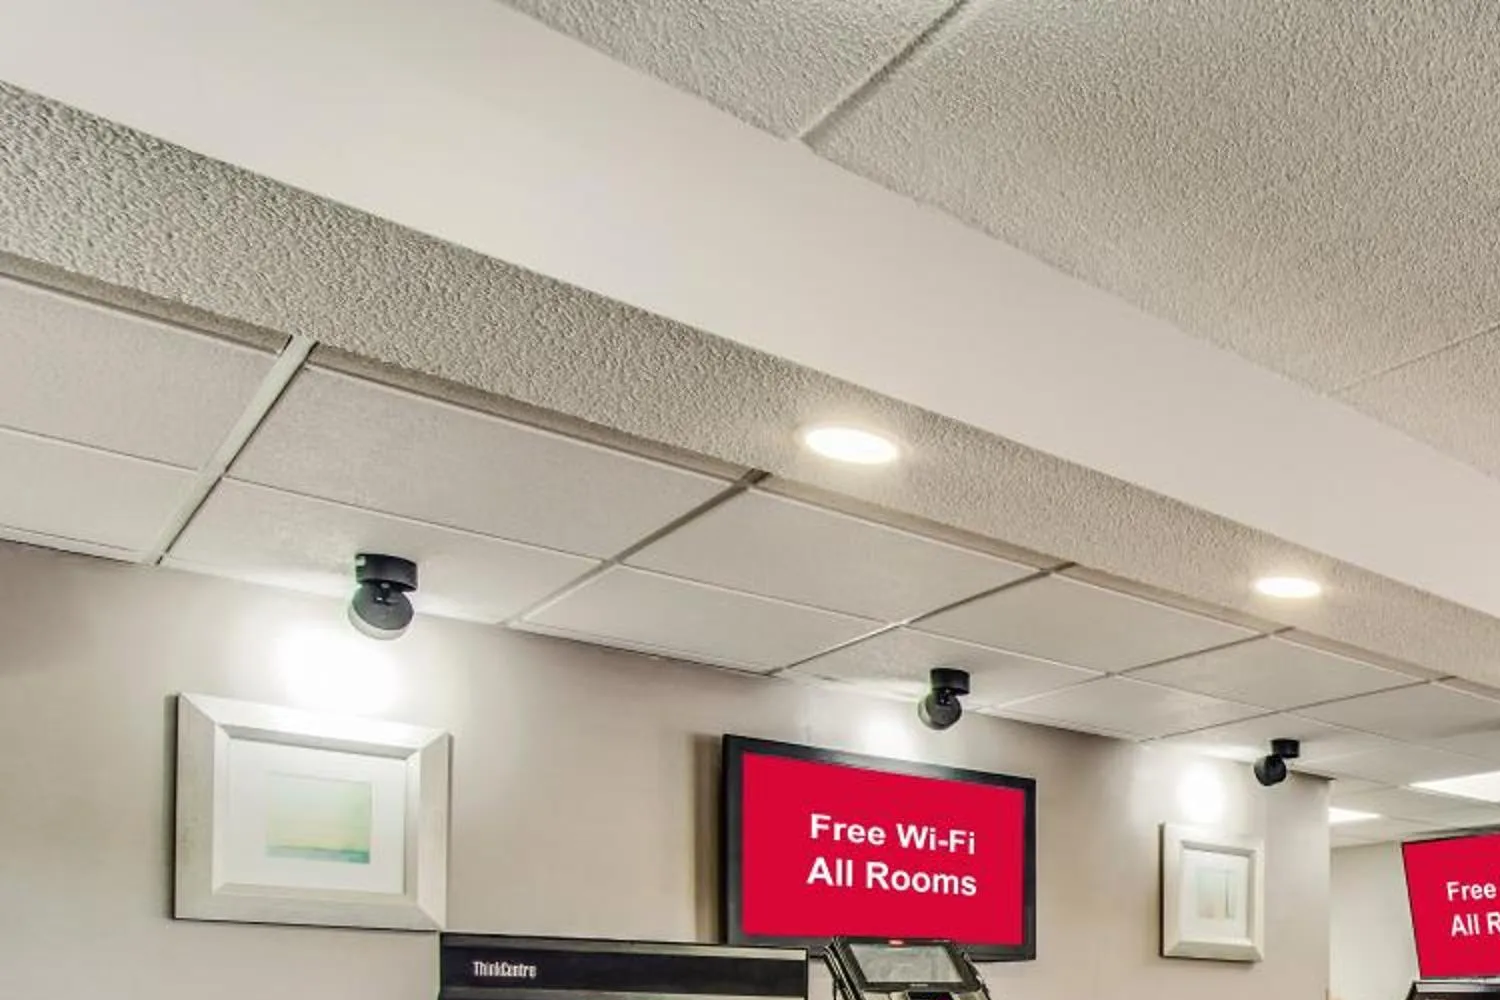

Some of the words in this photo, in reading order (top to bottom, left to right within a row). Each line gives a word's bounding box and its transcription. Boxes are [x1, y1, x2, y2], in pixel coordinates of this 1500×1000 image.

[809, 813, 887, 846] Free
[895, 822, 976, 856] Wi-Fi
[806, 856, 854, 888] All
[866, 861, 978, 897] Rooms
[1446, 881, 1497, 901] Free
[1450, 912, 1481, 937] All
